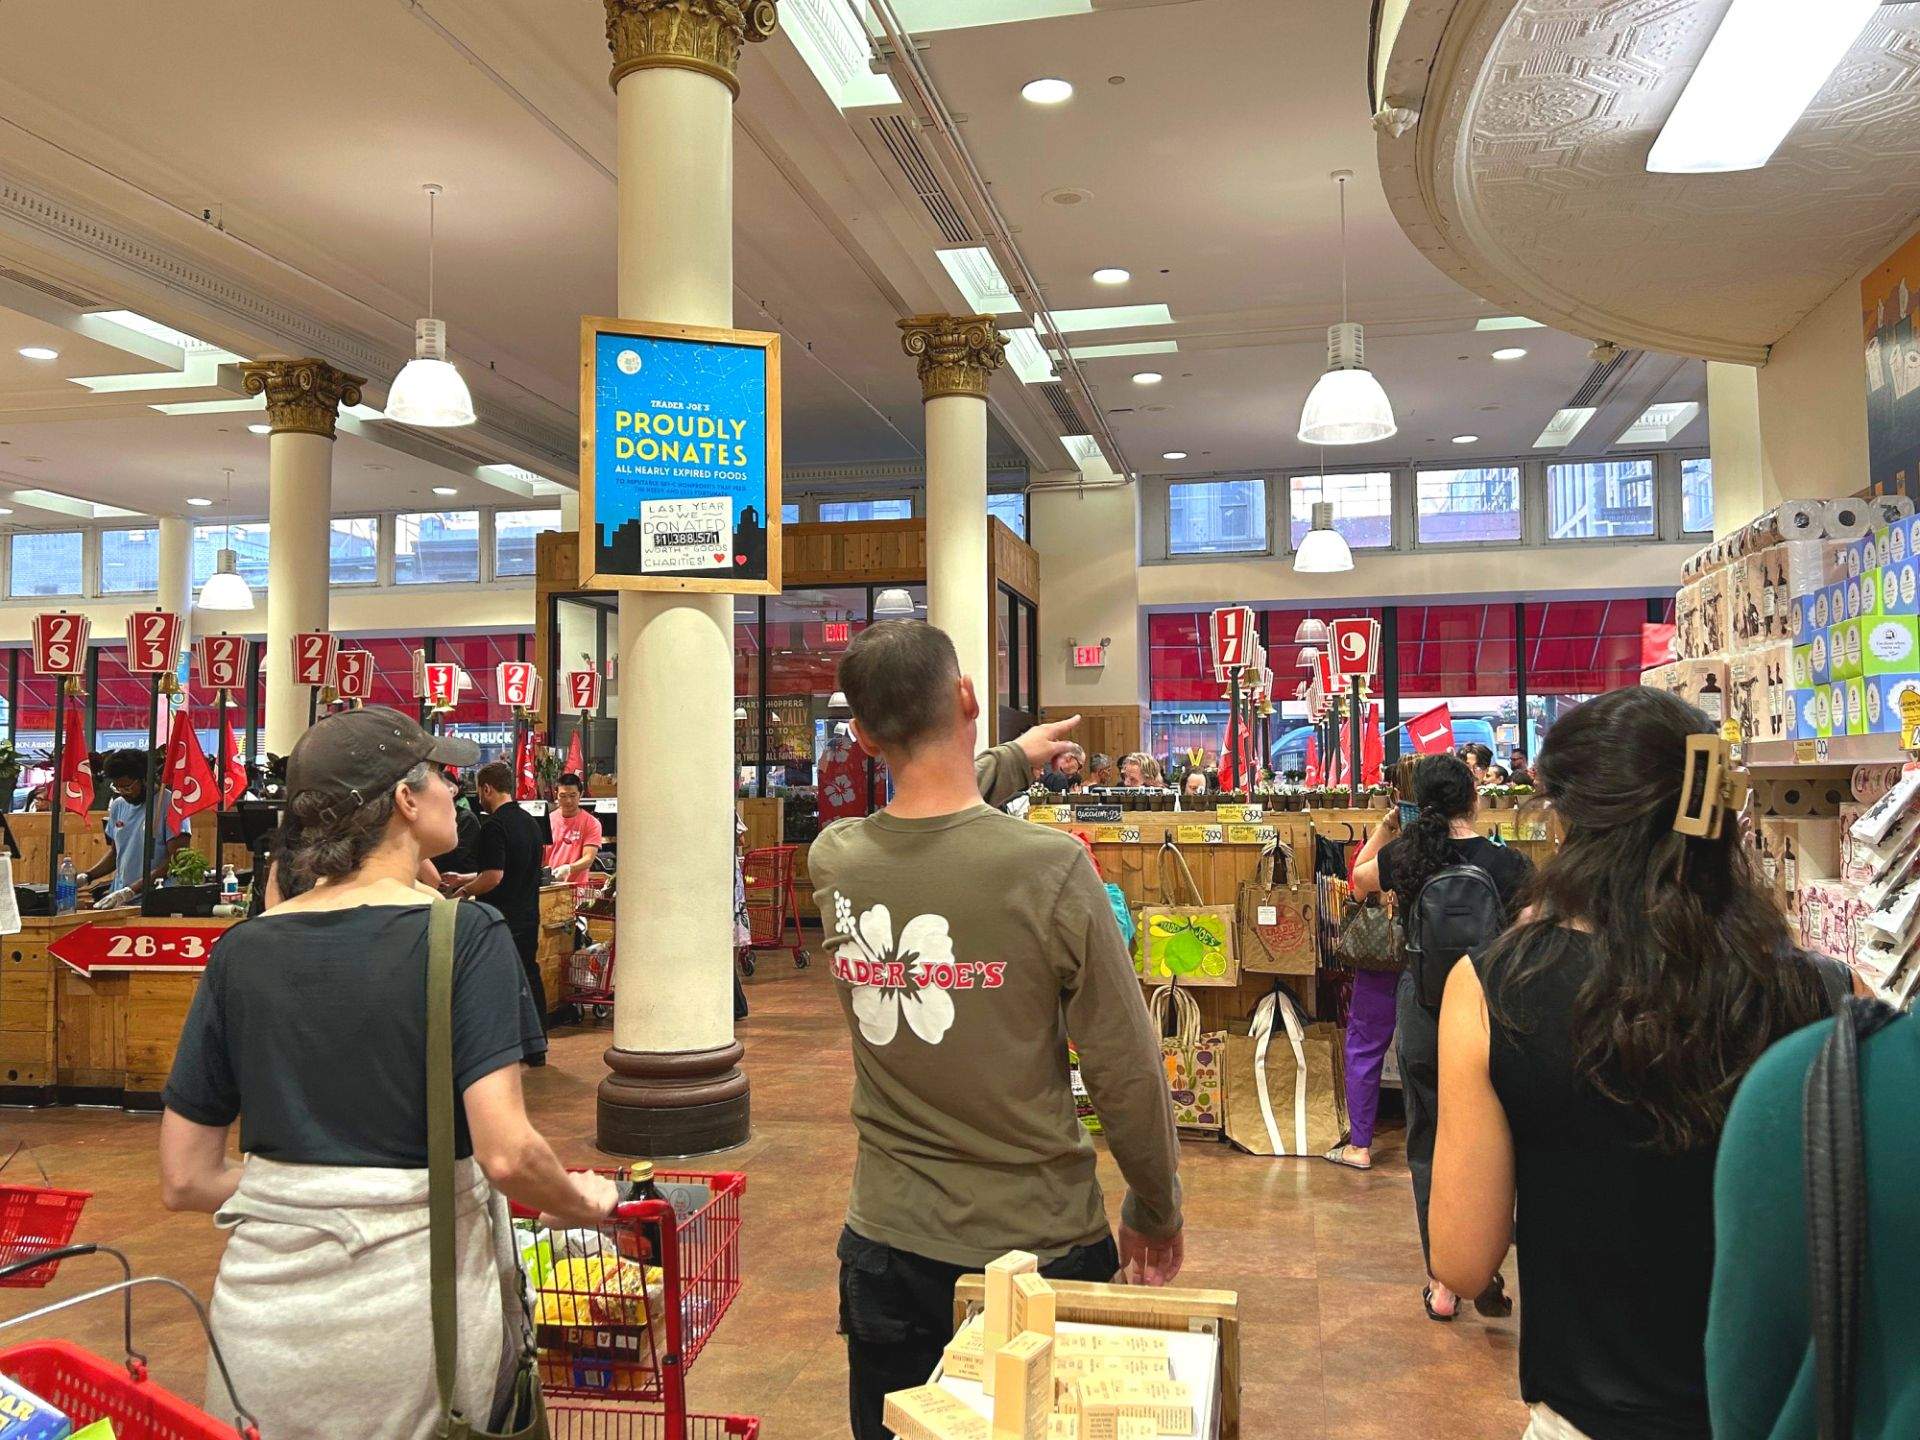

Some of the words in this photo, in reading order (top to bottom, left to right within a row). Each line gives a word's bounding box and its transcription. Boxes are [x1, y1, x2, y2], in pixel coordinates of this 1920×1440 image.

[650, 399, 684, 410] TRADER
[686, 403, 710, 412] JOE'S
[615, 410, 747, 441] PROUDLY
[615, 436, 747, 467] DONATES
[615, 464, 632, 474] ALL
[635, 465, 670, 476] NEARLY
[673, 468, 711, 479] EXPIRED
[714, 471, 748, 481] FOODS
[649, 504, 683, 513] LAST
[692, 502, 724, 511] YEAR
[643, 518, 726, 534] DONATED
[644, 546, 681, 554] WORTH
[693, 544, 728, 553] GOODS
[142, 616, 165, 668] 23
[825, 623, 849, 642] EXIT
[48, 618, 71, 669] 28
[1341, 632, 1367, 661] 9
[213, 640, 234, 684] 29
[304, 637, 323, 682] 24
[1077, 647, 1101, 666] EXIT
[507, 666, 525, 702] 26
[766, 699, 804, 708] HOPPERS
[1180, 713, 1208, 724] CAVA
[1193, 926, 1216, 946] JOE'S
[912, 960, 1008, 990] JOE'S
